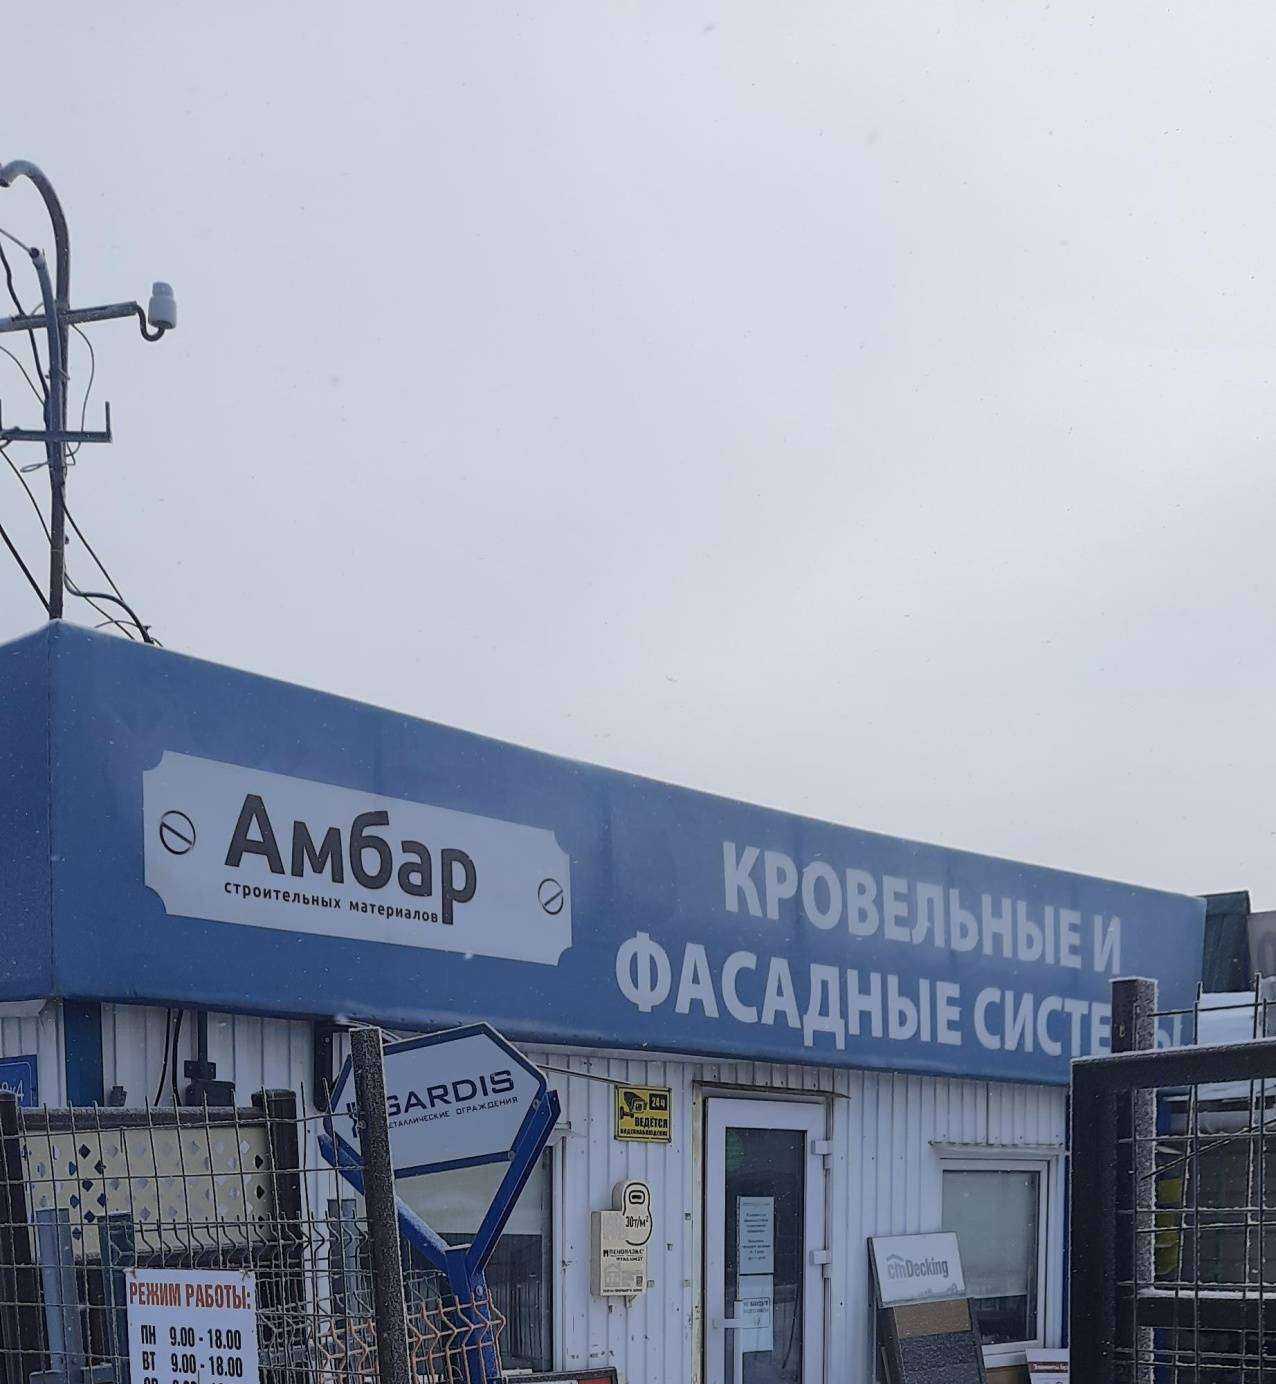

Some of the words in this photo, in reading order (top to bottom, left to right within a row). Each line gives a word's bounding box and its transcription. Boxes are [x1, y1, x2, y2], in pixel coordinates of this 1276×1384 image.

[224, 793, 477, 925] Амбар
[224, 879, 341, 909] строительных
[348, 899, 439, 924] материалов
[722, 841, 1083, 969] КРОВЕЛЬНЫЕ
[1092, 914, 1122, 975] И
[615, 931, 963, 1050] ФАСАДНЫЕ
[973, 986, 1186, 1058] СИСТЕЫ
[456, 1096, 519, 1116] ОГРАЖДЕНИЯ
[129, 1281, 180, 1306] РЕЖИМ
[185, 1283, 251, 1309] РАБОТЫ:
[140, 1324, 157, 1345] ПН
[169, 1326, 195, 1347] 9.00
[207, 1328, 242, 1350] 18.00
[142, 1351, 156, 1371] ВТ
[171, 1353, 197, 1374] 9.00
[208, 1356, 243, 1378] 18.00
